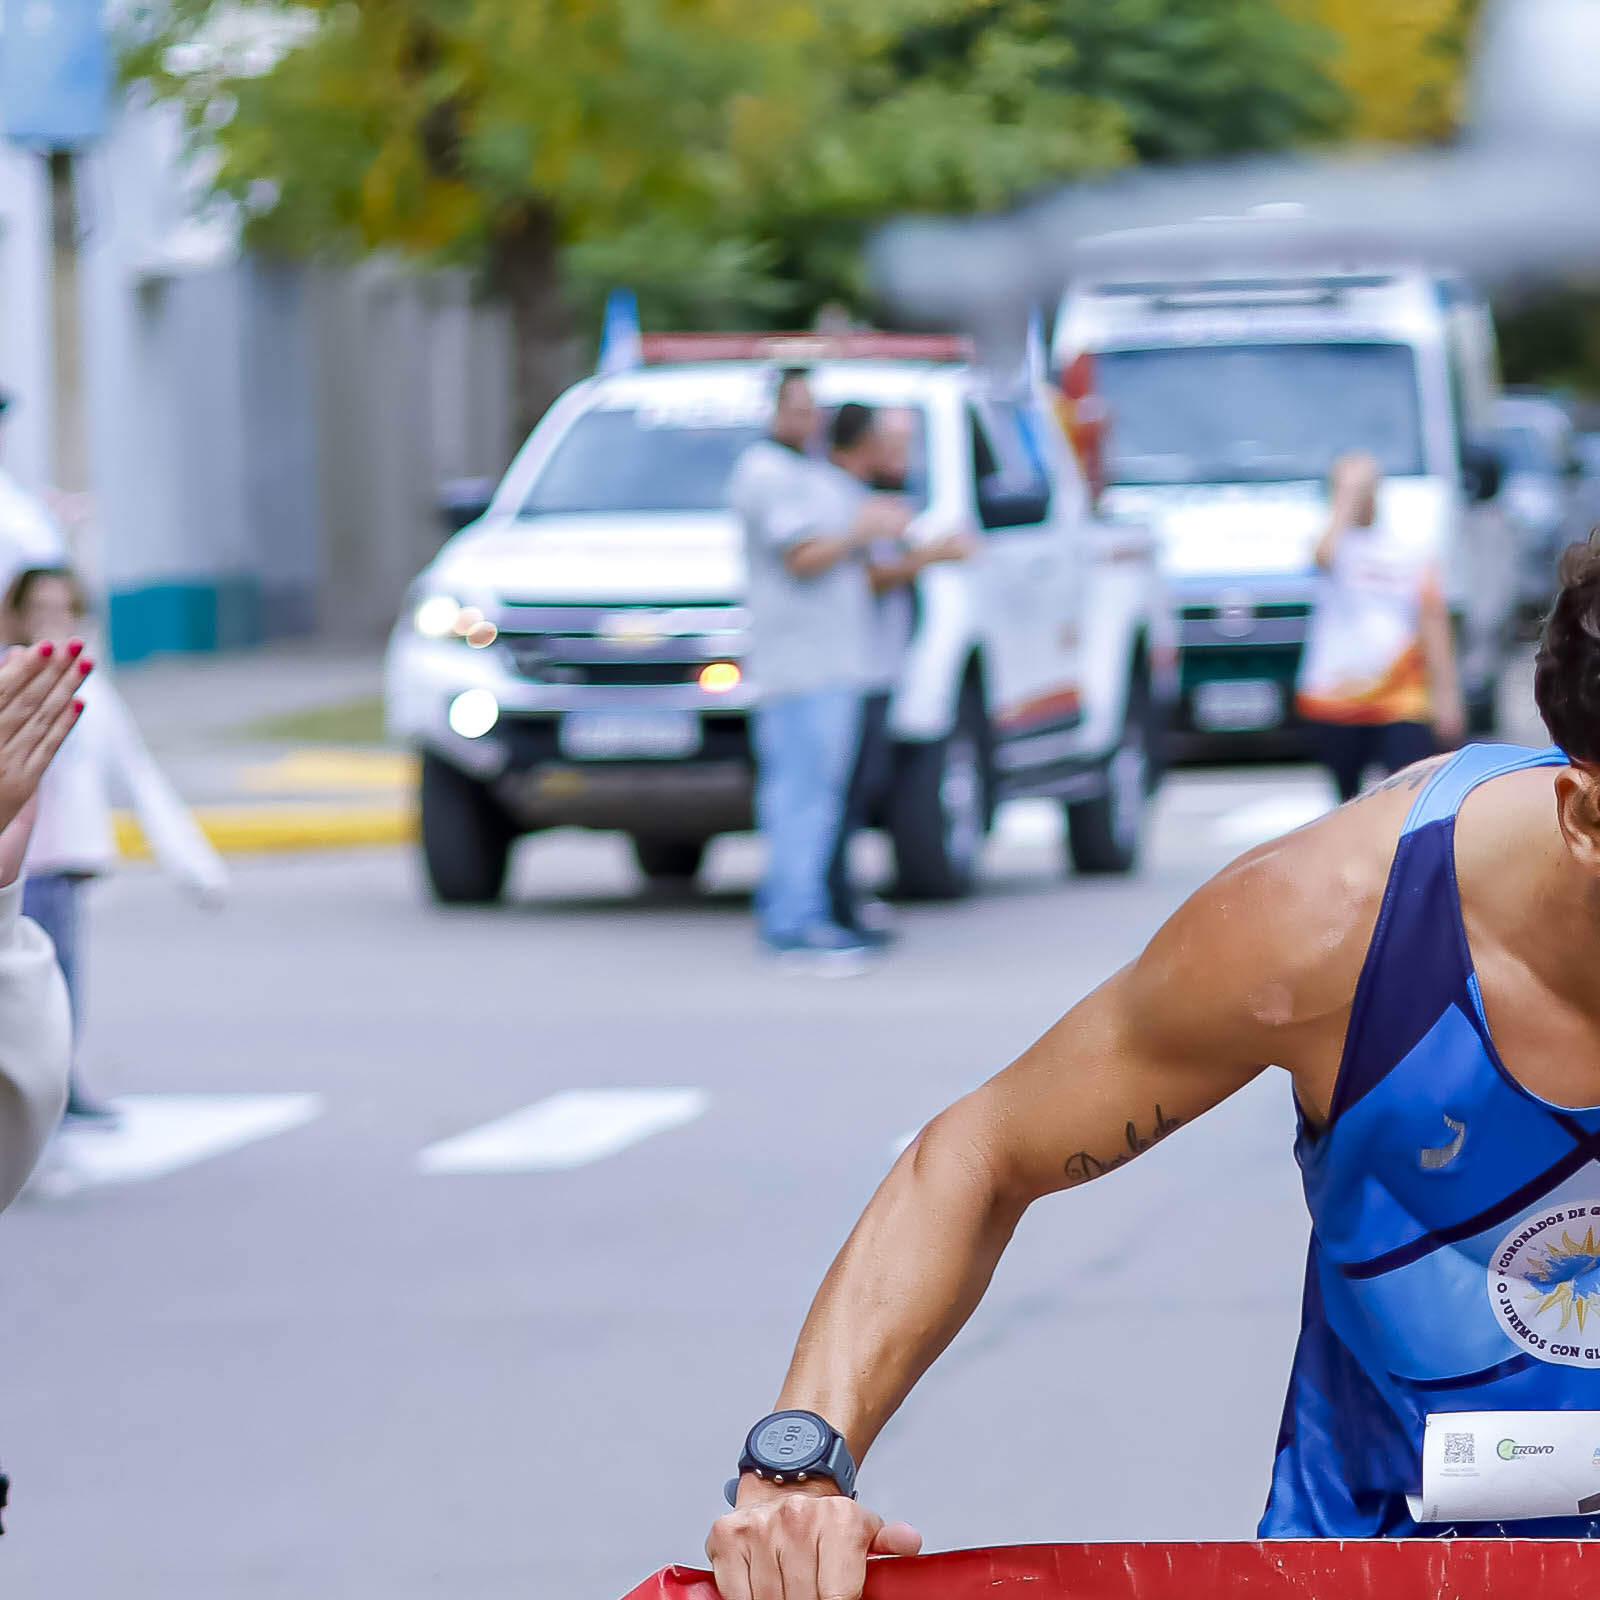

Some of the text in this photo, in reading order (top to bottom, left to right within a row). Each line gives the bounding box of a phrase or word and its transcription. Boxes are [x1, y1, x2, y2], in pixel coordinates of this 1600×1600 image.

[1499, 1212, 1565, 1268] CORONADOS
[1567, 1207, 1586, 1220] DE
[1500, 1298, 1547, 1350] JUREMOS
[1550, 1343, 1581, 1358] CON
[779, 1425, 802, 1455] 0.98
